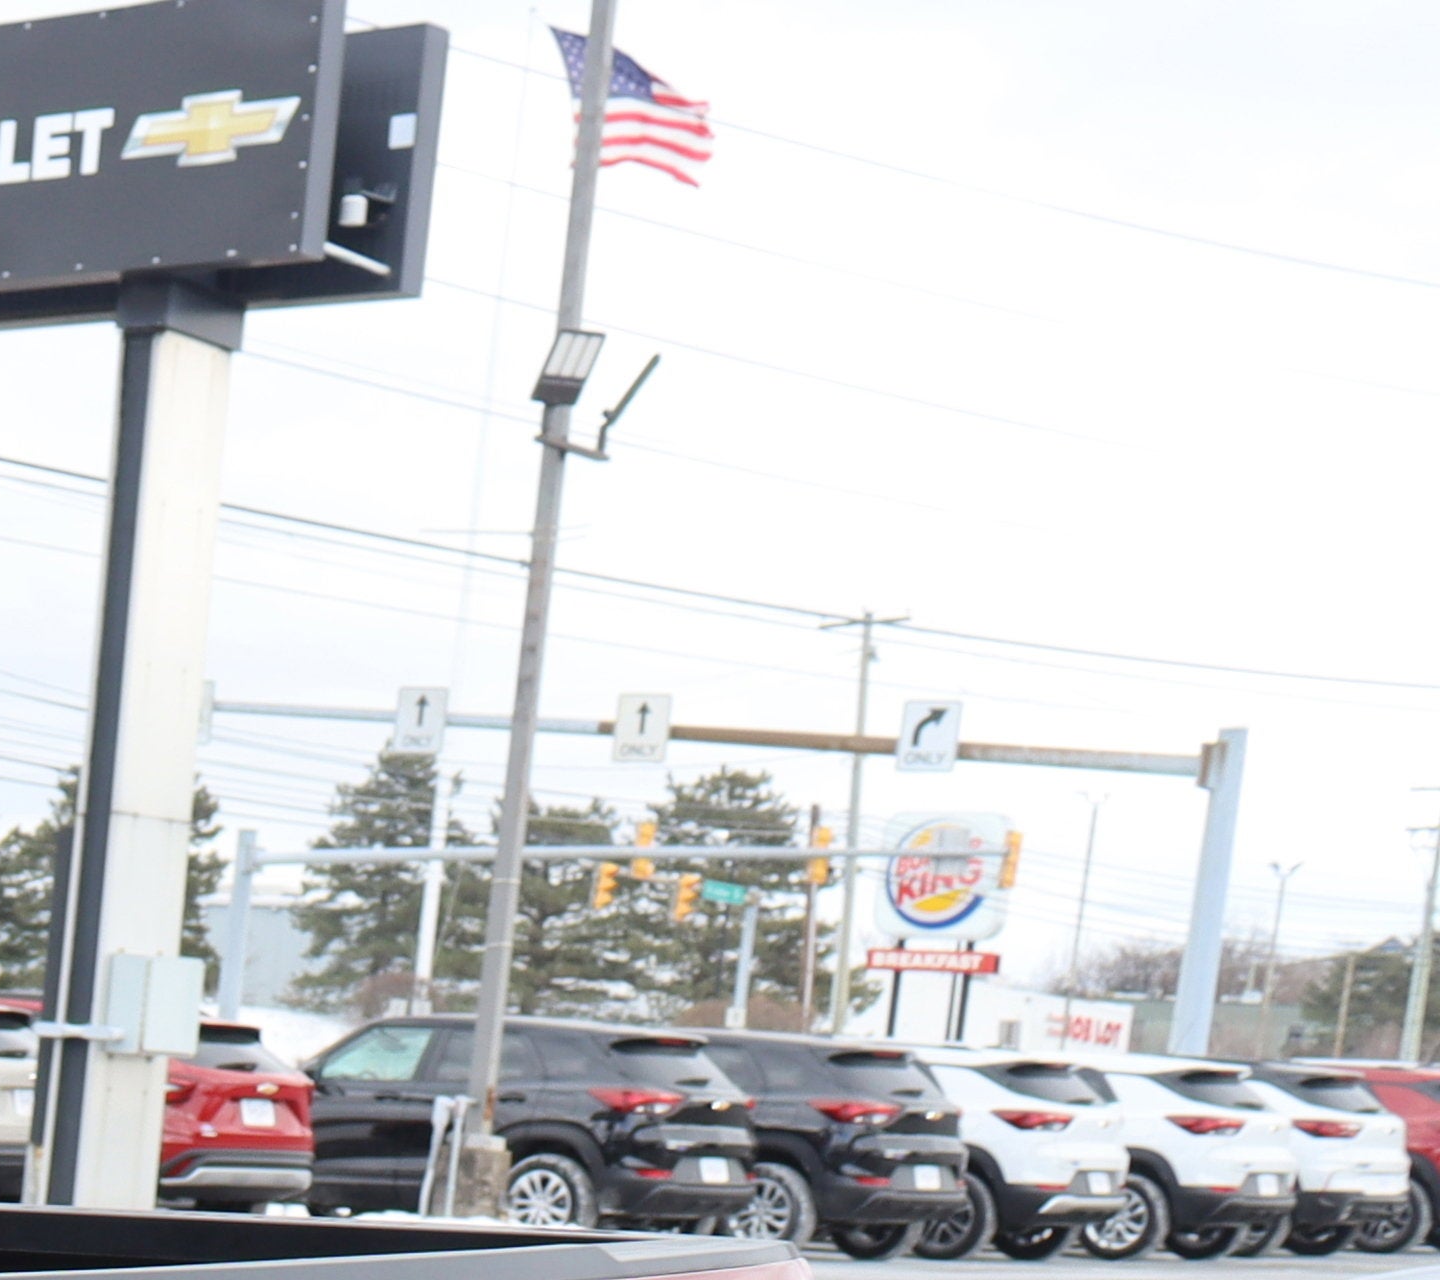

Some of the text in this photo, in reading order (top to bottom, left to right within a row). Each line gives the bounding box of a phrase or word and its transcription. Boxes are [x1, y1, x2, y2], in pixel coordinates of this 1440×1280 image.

[619, 742, 658, 757] ONLY
[903, 750, 947, 765] ONLY
[870, 951, 984, 971] BREAKFAST
